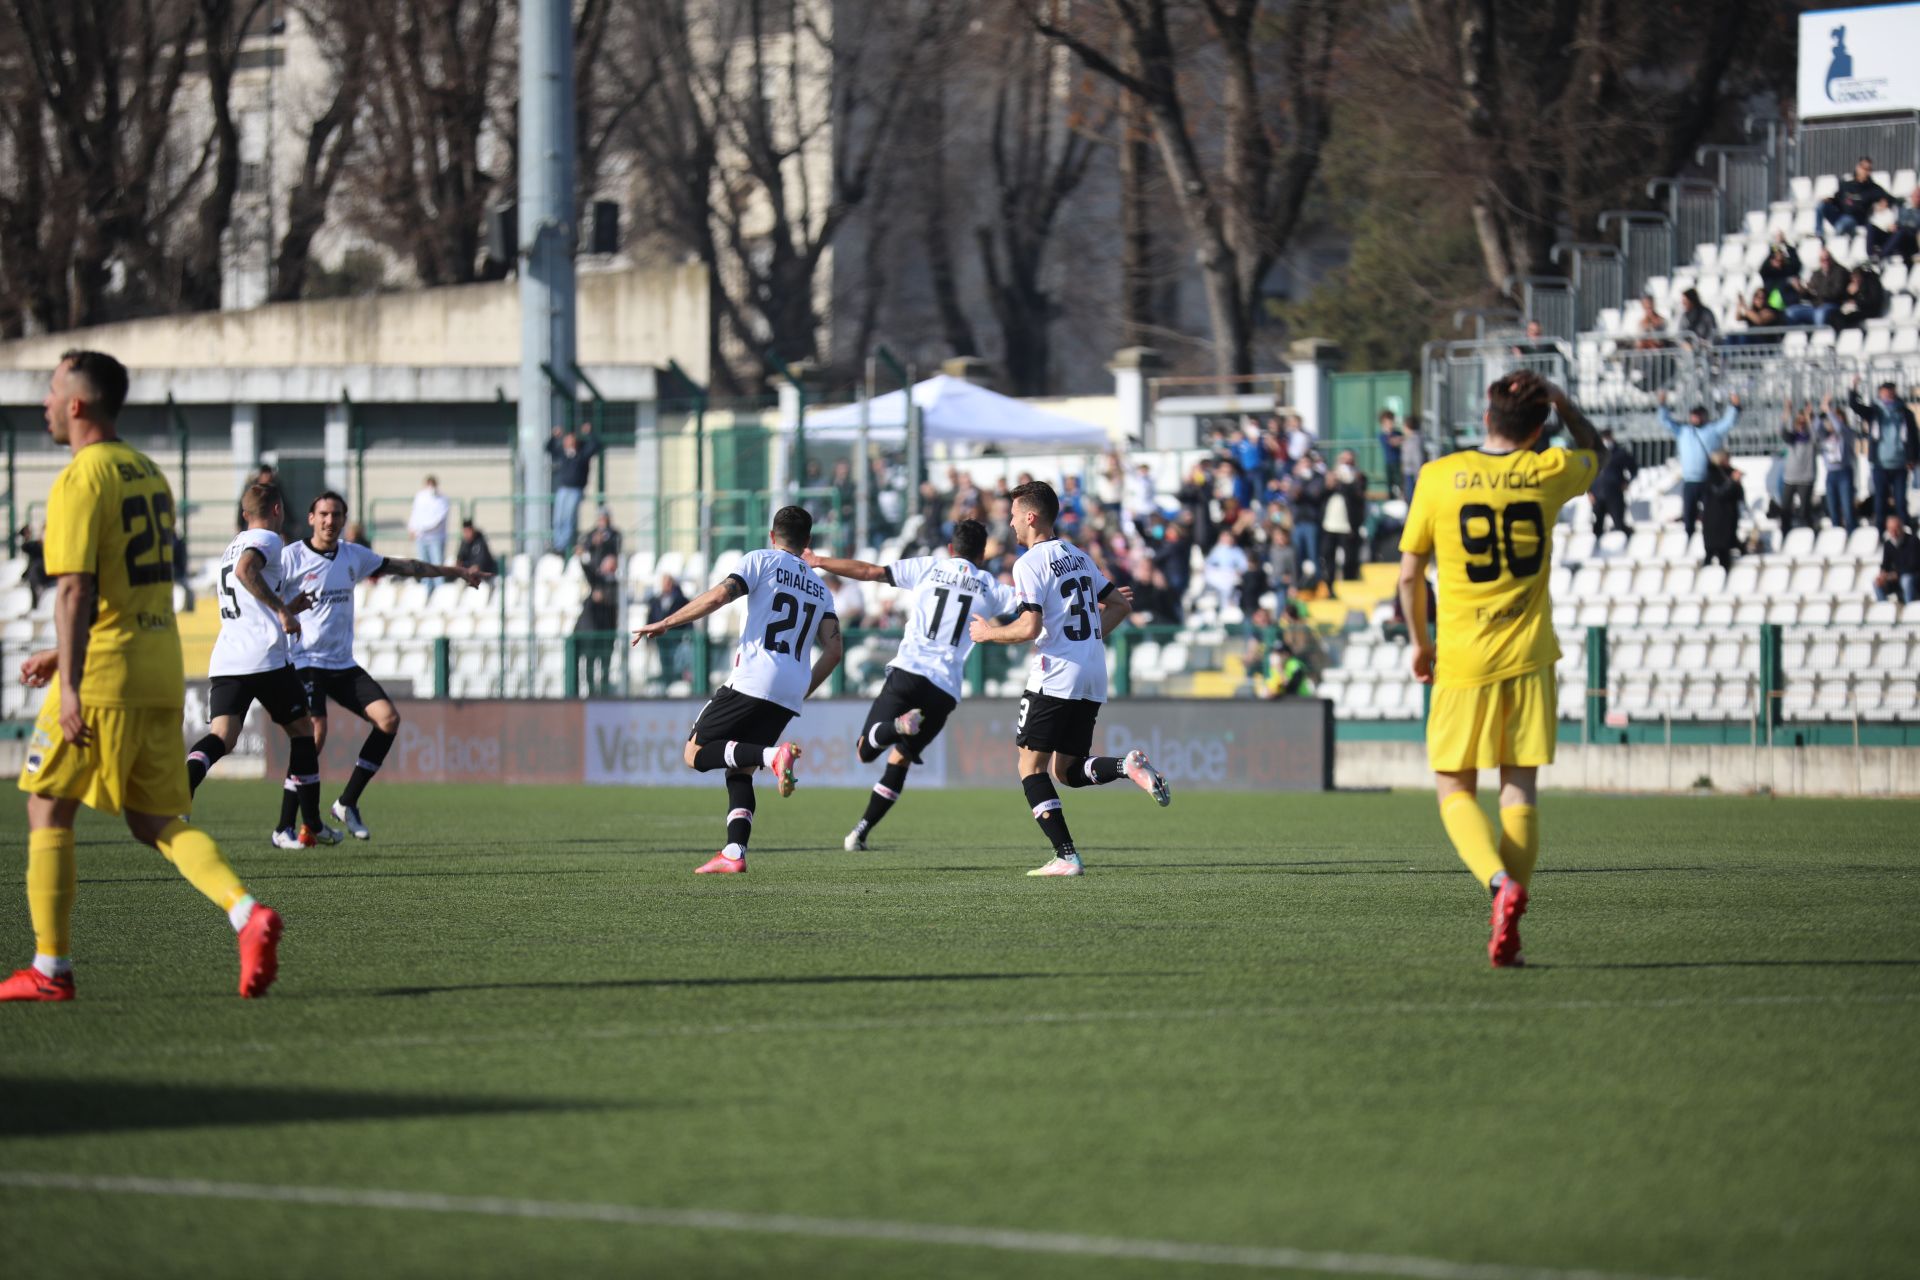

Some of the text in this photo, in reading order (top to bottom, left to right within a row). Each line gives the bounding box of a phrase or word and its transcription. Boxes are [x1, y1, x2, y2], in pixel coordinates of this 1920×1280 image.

[1459, 501, 1546, 583] 90
[776, 567, 825, 601] CRIALESE
[930, 568, 959, 587] DELLA
[764, 591, 817, 663] 21
[927, 587, 974, 648] 11
[399, 719, 500, 774] Palace
